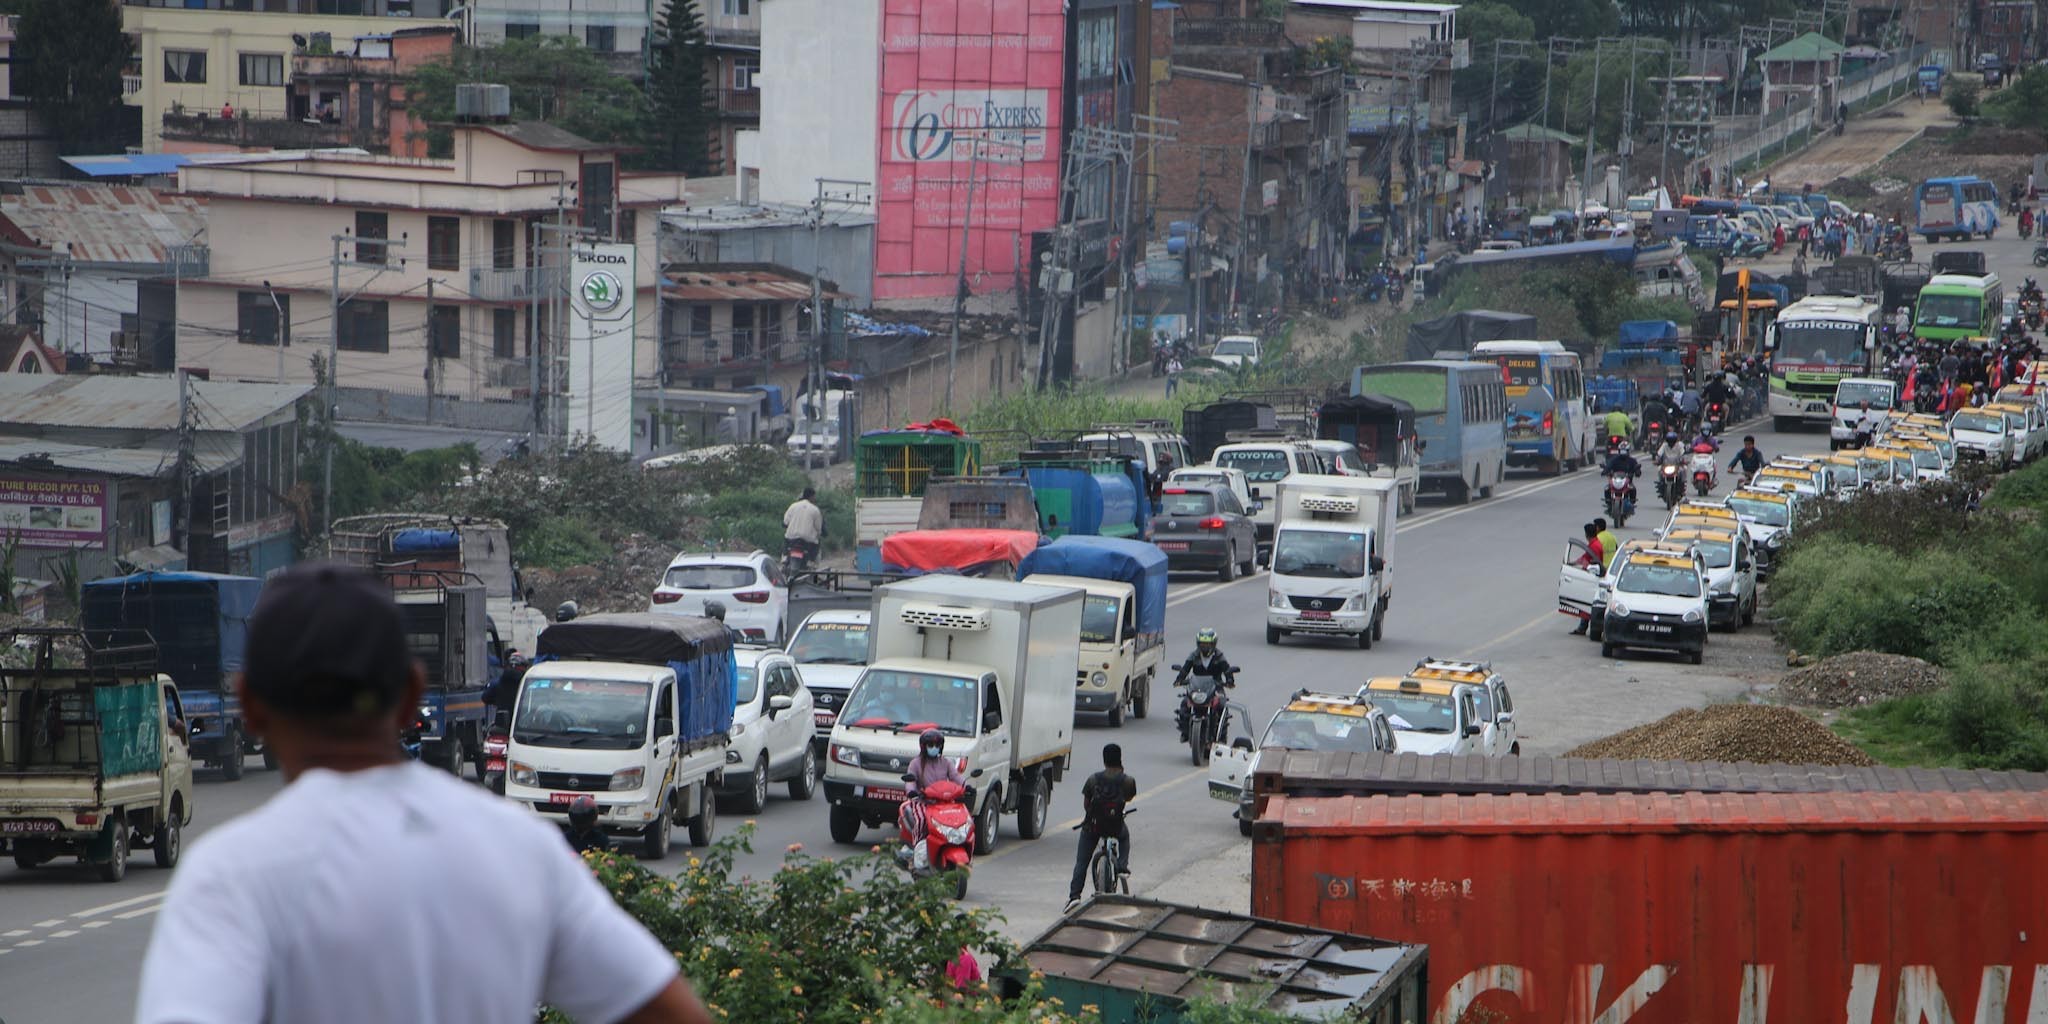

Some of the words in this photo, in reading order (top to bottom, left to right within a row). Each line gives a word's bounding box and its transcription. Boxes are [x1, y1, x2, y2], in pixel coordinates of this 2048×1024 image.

[942, 103, 982, 128] CITY
[984, 100, 1041, 129] EXPRESS
[578, 252, 627, 264] SKODA
[1508, 360, 1536, 368] DELUXE
[1231, 452, 1275, 460] TOYOTA
[27, 481, 58, 493] DECOR
[82, 483, 102, 495] LTD.
[1738, 964, 2048, 1024] LIN
